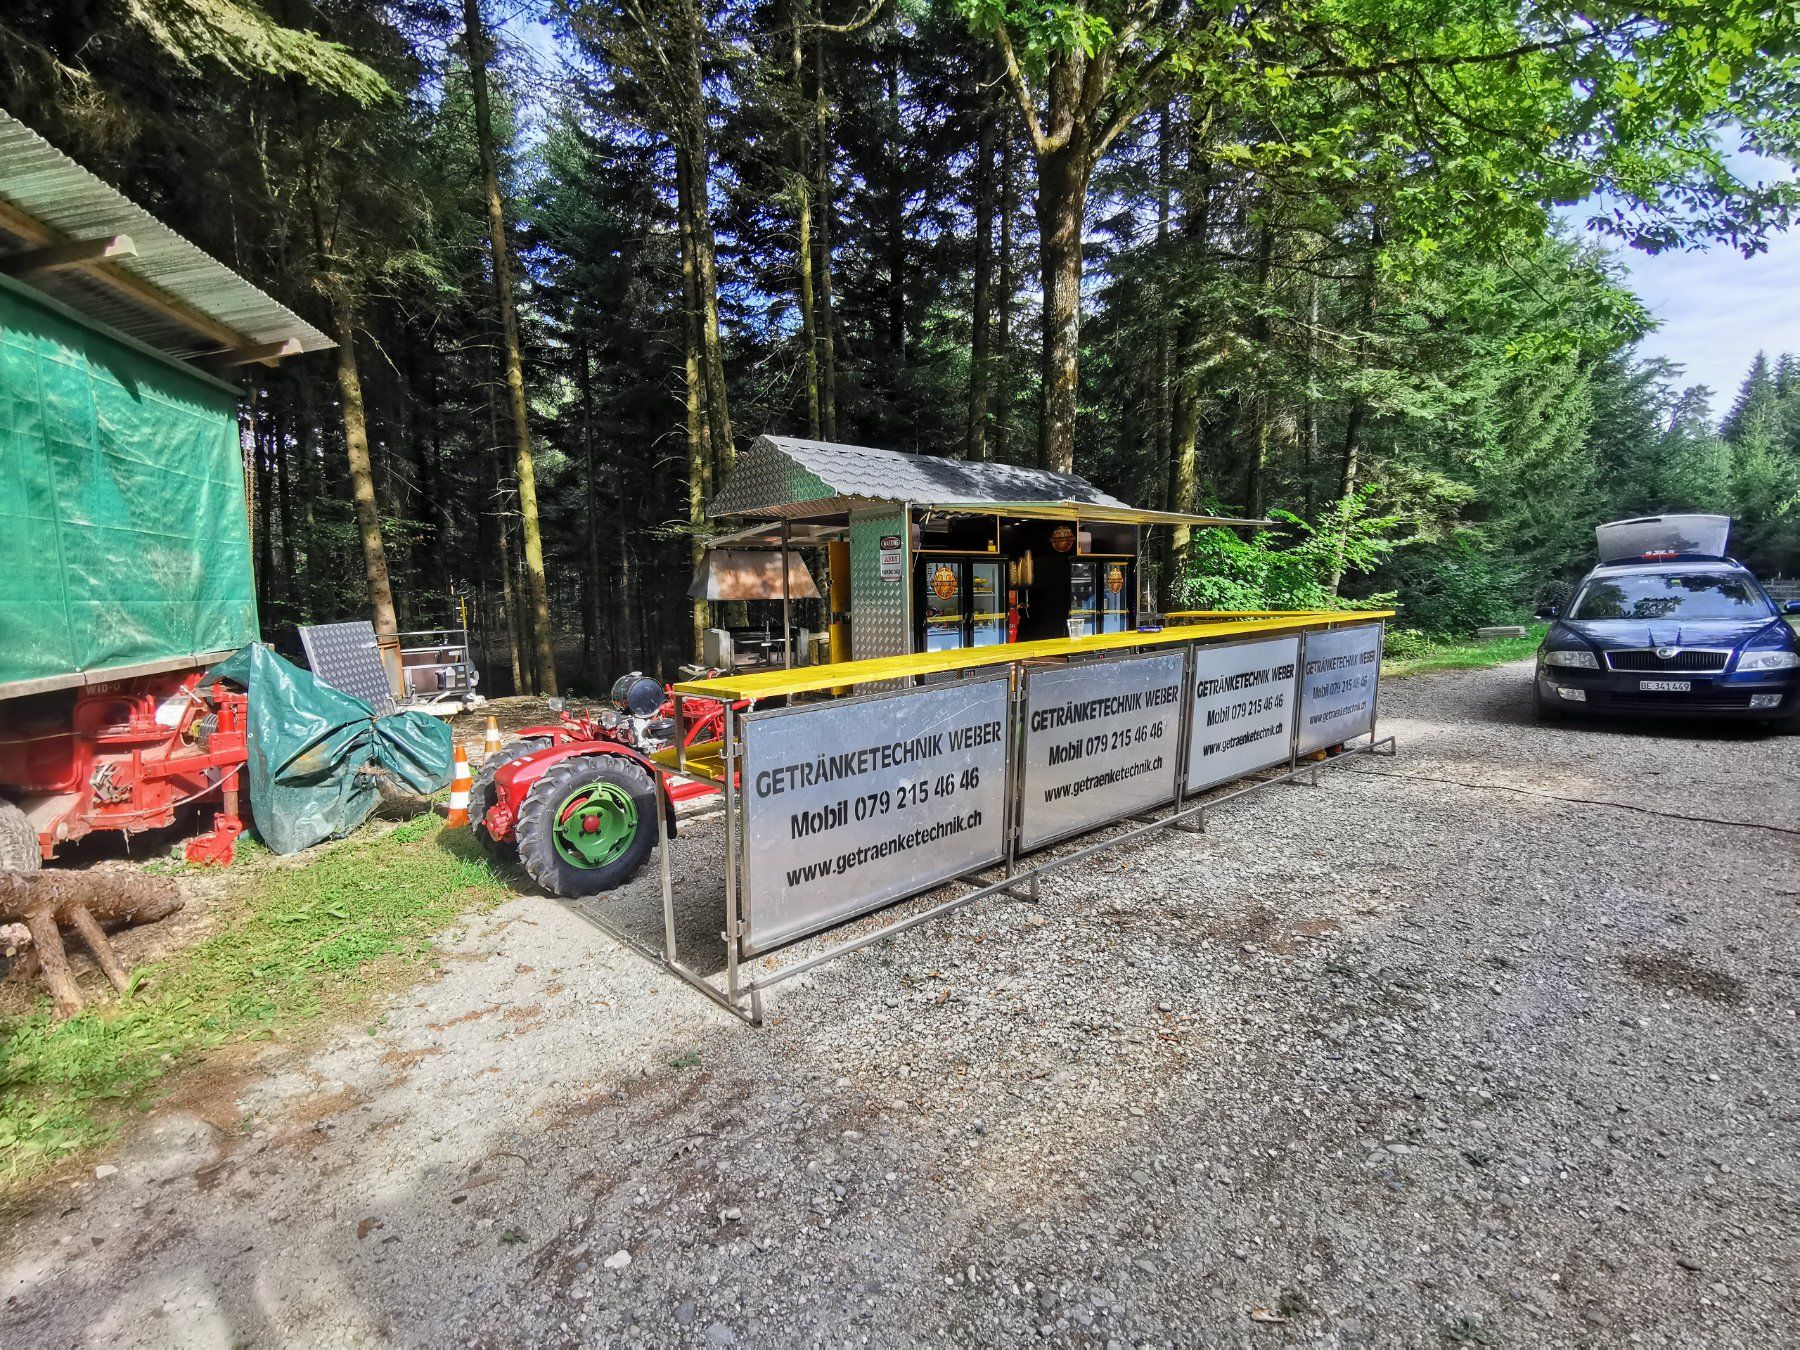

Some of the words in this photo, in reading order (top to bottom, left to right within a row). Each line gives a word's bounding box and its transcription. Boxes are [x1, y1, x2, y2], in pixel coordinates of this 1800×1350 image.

[1196, 668, 1270, 699] GETRÄNKETECHNIK
[1271, 664, 1295, 681] WEBER
[1305, 654, 1358, 675] GETRÄNKETECHNIK
[1330, 680, 1341, 696] 079
[1342, 679, 1352, 693] 215
[1031, 692, 1142, 732] GETRÄNKETECHNIK
[1145, 685, 1179, 708] WEBER
[1206, 706, 1231, 727] Mobil
[1231, 702, 1247, 720] 079
[1248, 698, 1262, 716] 215
[1263, 695, 1273, 711] 46
[1274, 693, 1284, 708] 46
[756, 732, 943, 798] GETRÄNKETECHNIK
[949, 720, 1002, 751] WEBER
[1048, 738, 1084, 766] Mobil
[1086, 734, 1108, 757] 079
[1111, 728, 1131, 750] 215
[1134, 724, 1147, 743] 46
[1150, 720, 1163, 740] 46
[1202, 721, 1283, 757] www.getraenketechnik.ch
[1044, 755, 1163, 803] www.getraenketechnik.ch
[791, 800, 848, 839] Mobil
[854, 790, 890, 822] 079
[897, 780, 929, 810] 215
[934, 772, 954, 798] 46
[960, 766, 980, 791] 46
[787, 809, 982, 887] www.getraenketechnik.ch
